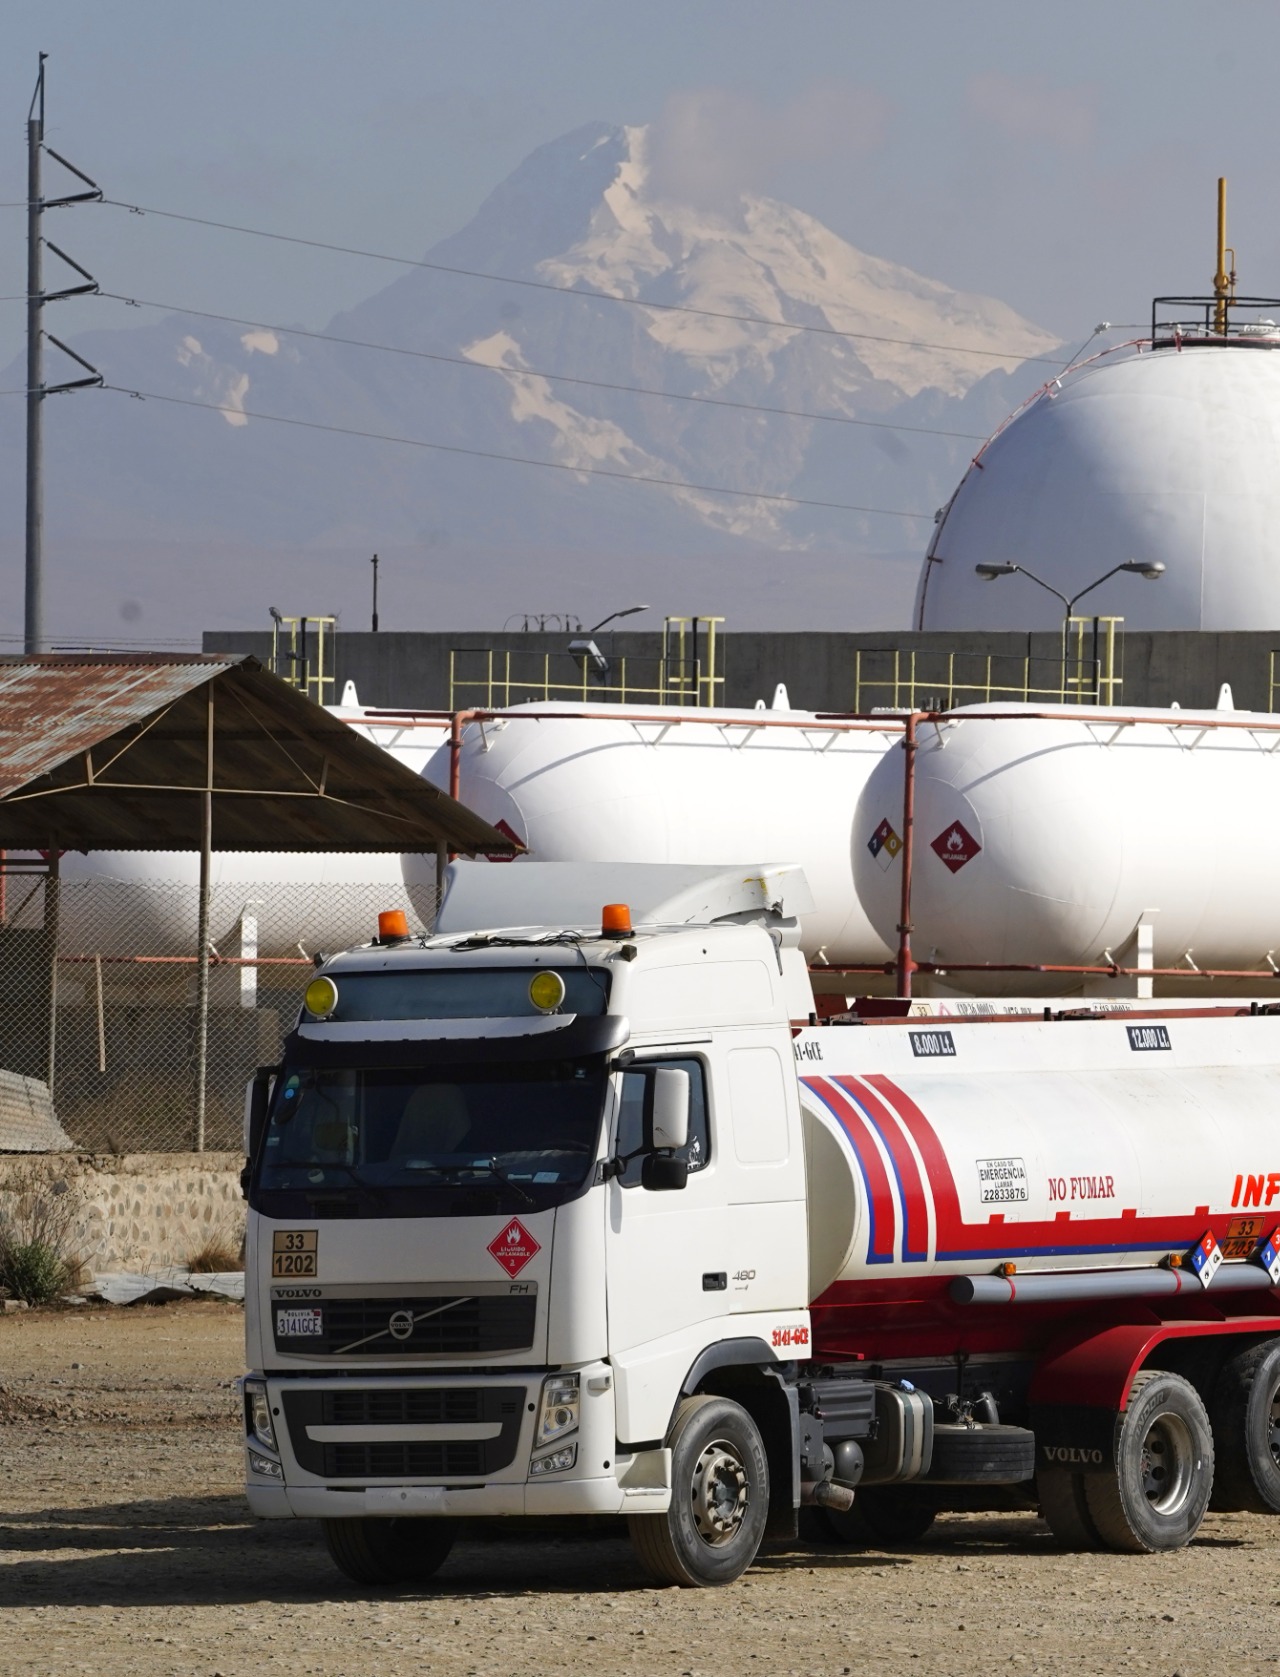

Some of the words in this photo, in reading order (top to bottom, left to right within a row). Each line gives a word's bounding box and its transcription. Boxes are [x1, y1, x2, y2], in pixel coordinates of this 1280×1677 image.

[881, 827, 888, 837] 4
[913, 1034, 940, 1054] 8.000
[939, 1034, 955, 1054] Lt.
[1131, 1029, 1158, 1048] 12.000
[1157, 1029, 1170, 1048] Lt.
[980, 1167, 1025, 1180] EMERGENCIA
[984, 1188, 1026, 1200] 22833876
[1048, 1178, 1067, 1201] NO
[1070, 1176, 1115, 1200] FUMAR
[1238, 1221, 1254, 1236] 33
[285, 1234, 304, 1250] 33
[1206, 1239, 1212, 1249] 2
[1275, 1234, 1280, 1244] 3
[1223, 1240, 1255, 1256] 1203
[275, 1255, 314, 1273] 1202
[732, 1269, 756, 1280] 480
[275, 1289, 322, 1298] VOLVO
[510, 1285, 528, 1294] FH
[279, 1318, 319, 1334] 3141GCE
[771, 1327, 809, 1346] 3141-GCE
[1043, 1446, 1103, 1464] VOLVO
